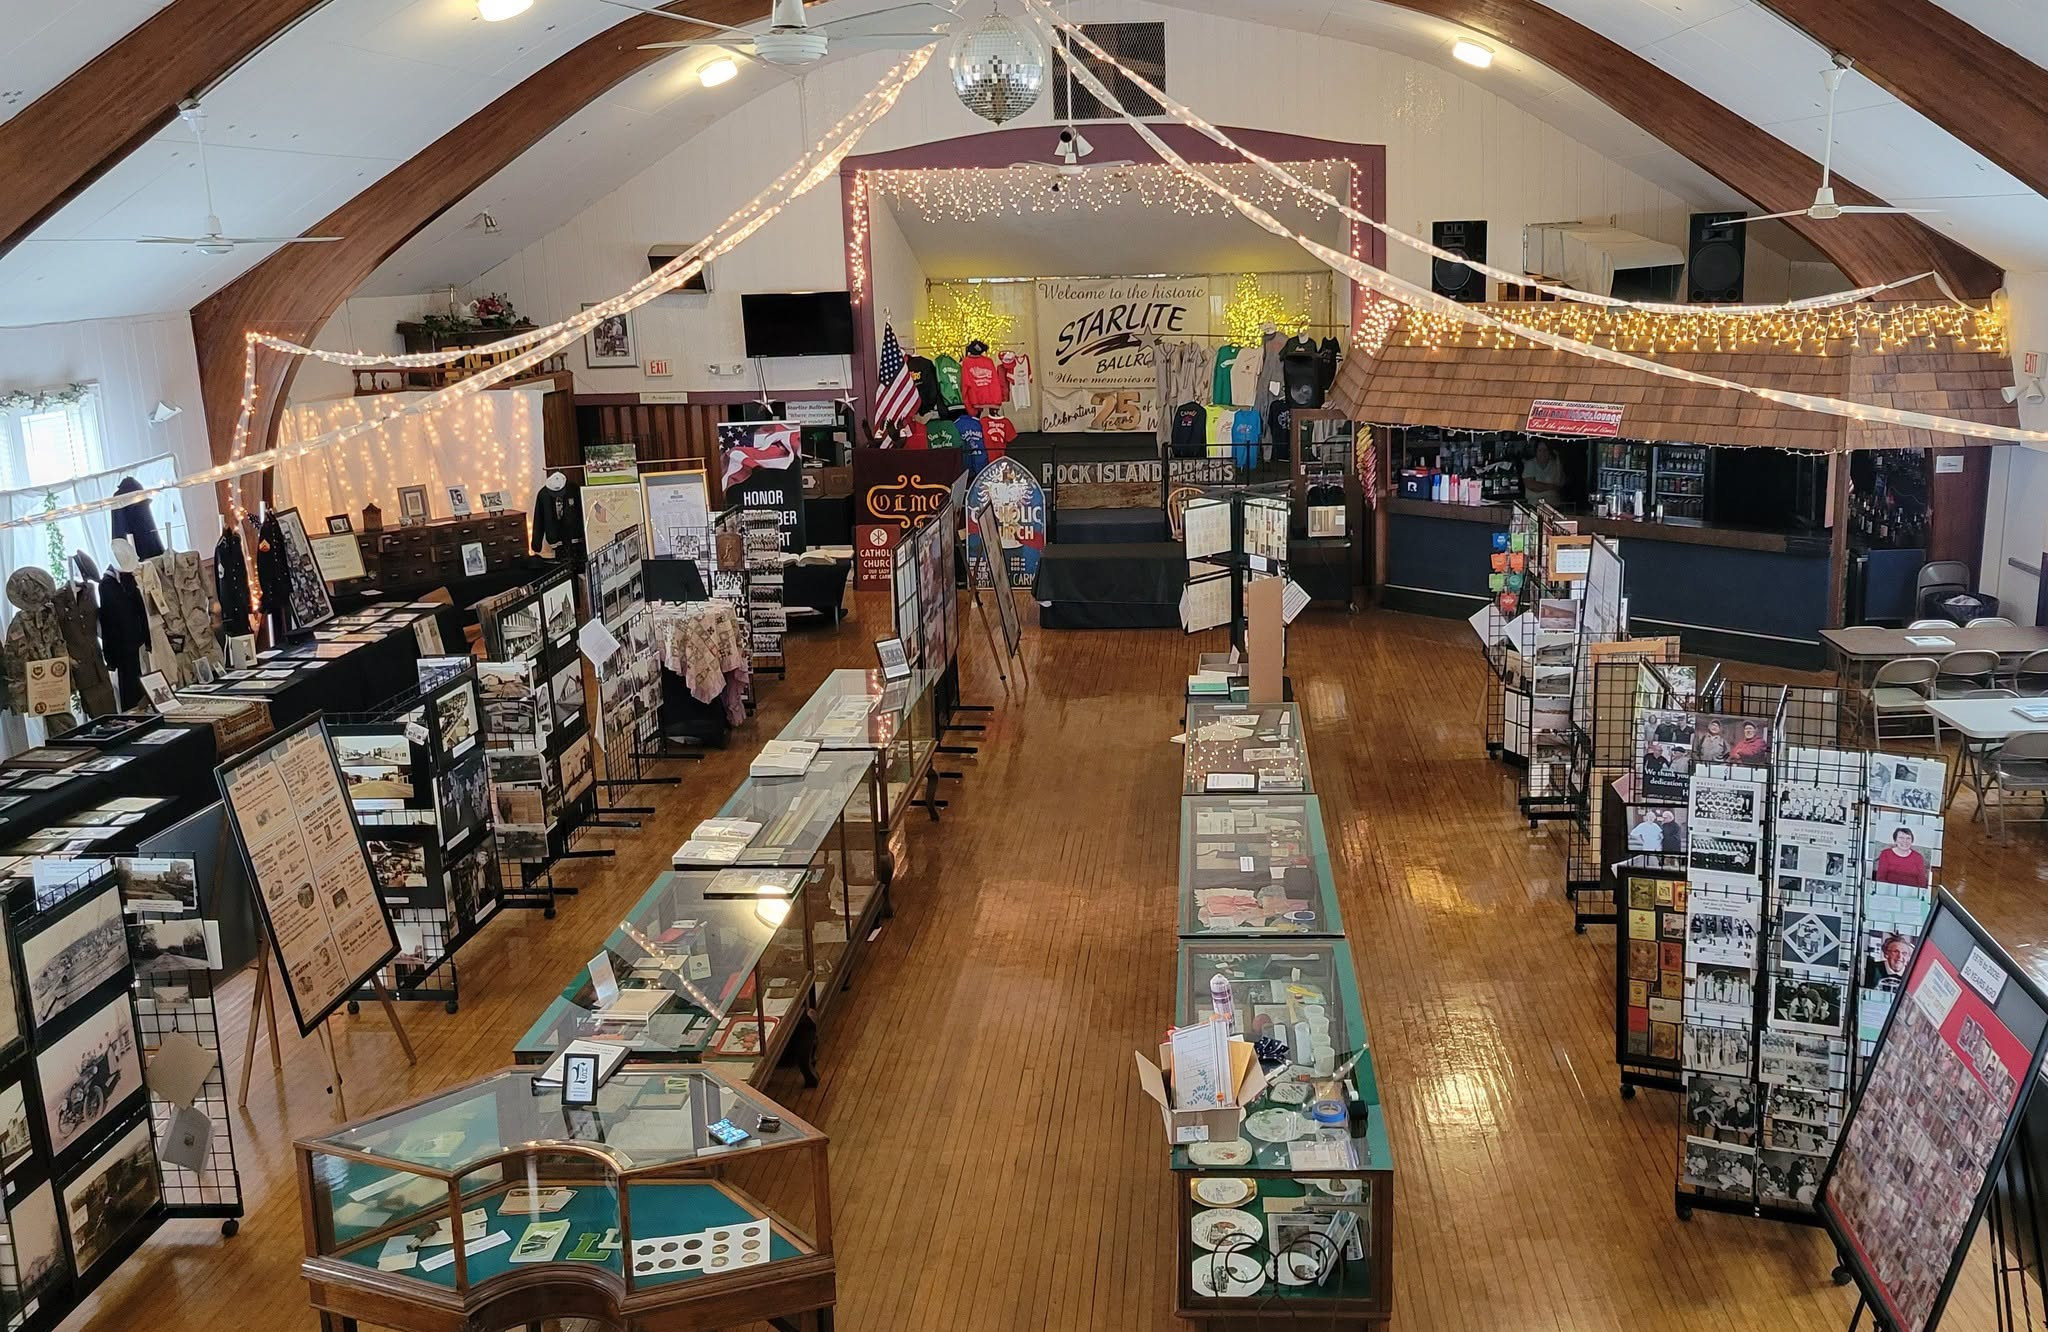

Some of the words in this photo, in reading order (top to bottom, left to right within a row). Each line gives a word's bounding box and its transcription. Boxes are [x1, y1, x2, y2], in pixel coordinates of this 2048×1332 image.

[1039, 283, 1106, 300] Welcome
[1108, 287, 1123, 300] to
[1126, 283, 1149, 300] the
[1151, 283, 1206, 299] historic
[1056, 302, 1187, 356] STARLITE
[650, 361, 667, 375] EXIT
[1096, 352, 1154, 374] BALLRO
[1091, 374, 1141, 384] memories
[1042, 404, 1097, 431] Celebrating
[1088, 391, 1142, 431] 25
[1142, 400, 1152, 413] of
[1102, 416, 1134, 431] years
[1530, 419, 1546, 428] Feel
[1546, 420, 1556, 429] the
[1583, 424, 1599, 433] good
[1042, 463, 1091, 484] ROCK
[1097, 463, 1162, 483] ISLAND
[744, 489, 784, 507] HONOR
[860, 549, 891, 558] CATHOL
[863, 560, 890, 568] CHURC
[1657, 769, 1676, 778] thank
[1650, 778, 1682, 788] dedication
[1971, 973, 1986, 989] YEARS
[1985, 985, 1997, 999] AGO
[565, 1232, 612, 1261] L
